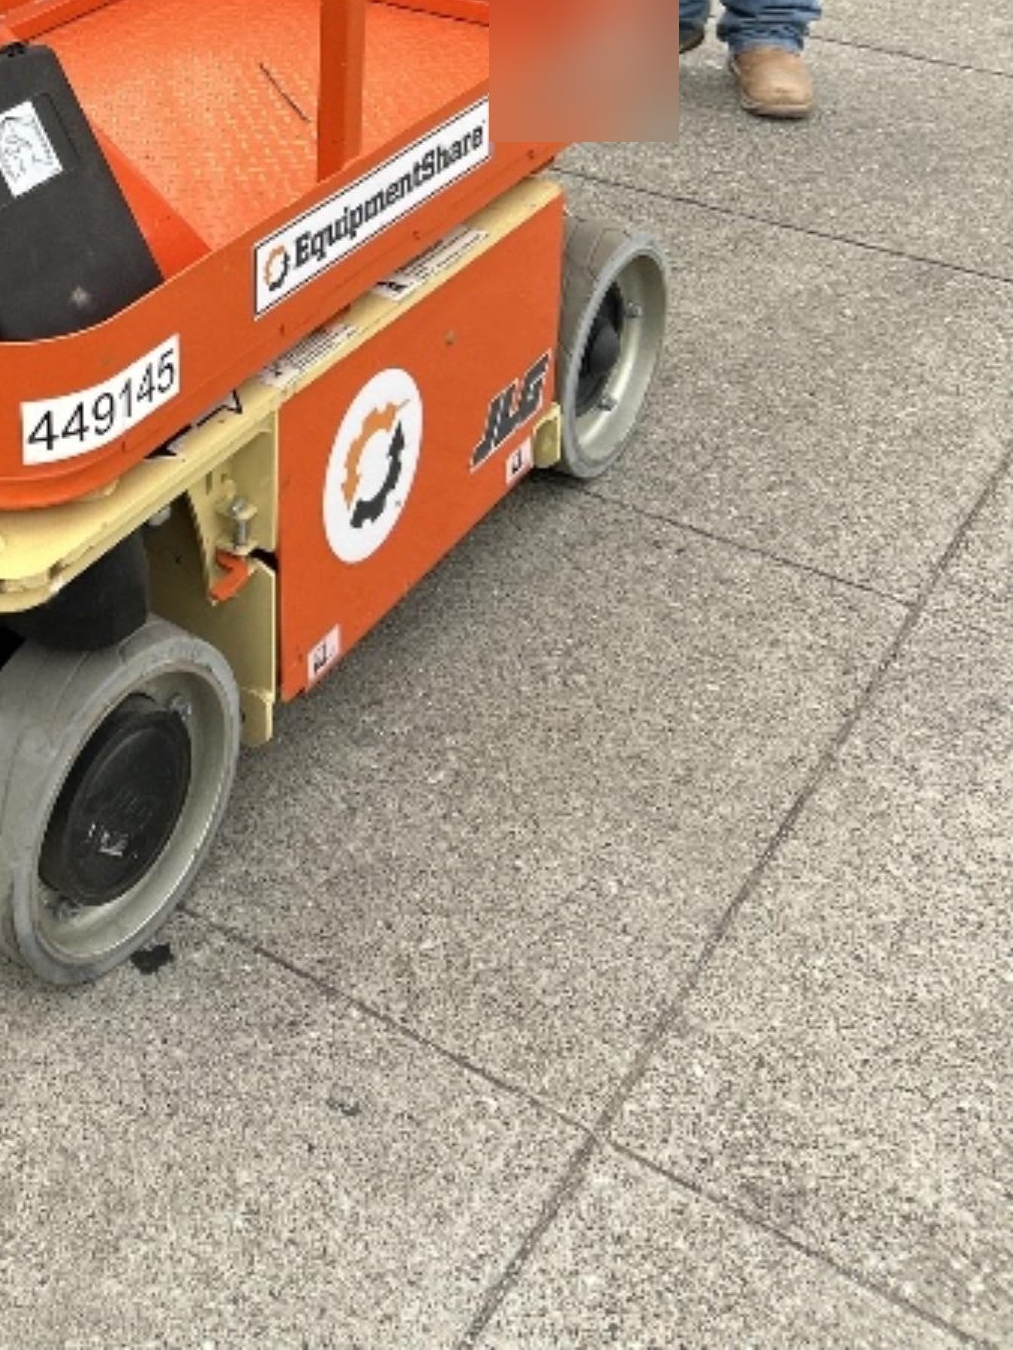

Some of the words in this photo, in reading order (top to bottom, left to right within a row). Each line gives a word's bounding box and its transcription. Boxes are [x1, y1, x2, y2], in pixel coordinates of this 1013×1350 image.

[294, 125, 483, 268] EquipmentShare
[28, 346, 175, 451] 449145
[470, 348, 552, 474] JLG
